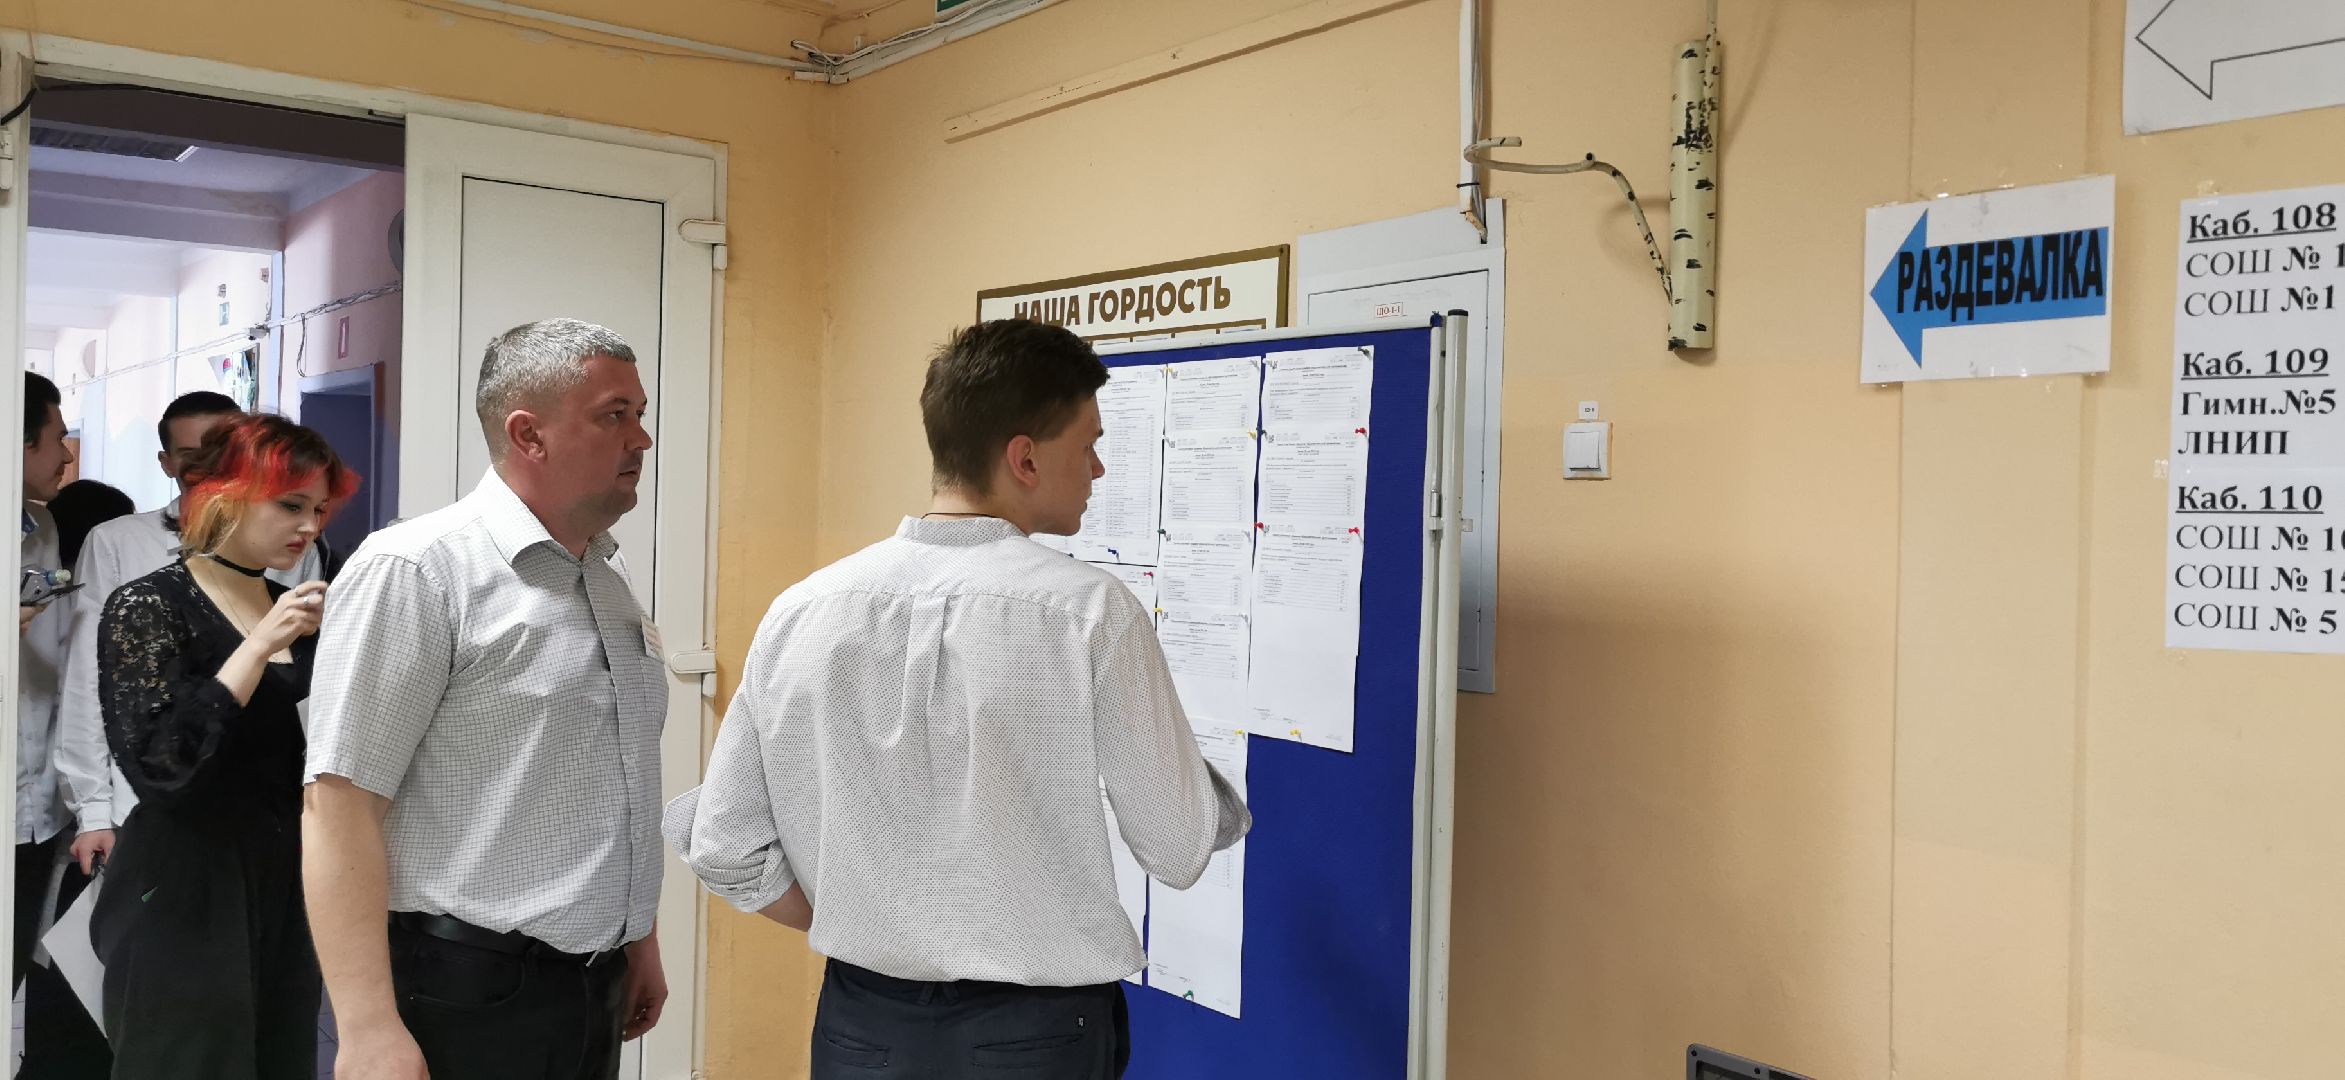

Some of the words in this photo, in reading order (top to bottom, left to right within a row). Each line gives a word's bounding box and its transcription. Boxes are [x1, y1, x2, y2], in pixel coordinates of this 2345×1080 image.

[2189, 210, 2259, 239] Каб.
[2273, 203, 2336, 231] 108
[1897, 229, 2103, 322] РАЗДЕВАЛКА
[2186, 248, 2271, 277] СОШ
[2283, 245, 2320, 272] №
[1015, 295, 1080, 327] НАША
[1088, 276, 1231, 324] ГОРДОСТЬ
[2184, 289, 2269, 316] СОШ
[2281, 285, 2334, 311] №1
[2182, 351, 2252, 377] Каб.
[2265, 348, 2329, 375] 109
[2177, 431, 2290, 455] ЛНИП
[2178, 485, 2247, 511] Каб.
[2260, 485, 2323, 510] 110
[2176, 525, 2259, 550] СОШ
[2271, 526, 2309, 551] №
[2323, 527, 2345, 551] 1
[2175, 564, 2259, 590] СОШ
[2271, 567, 2308, 592] №
[2322, 568, 2345, 594] 1
[2174, 602, 2258, 630] СОШ
[2270, 607, 2307, 634] №
[2319, 609, 2337, 635] 5
